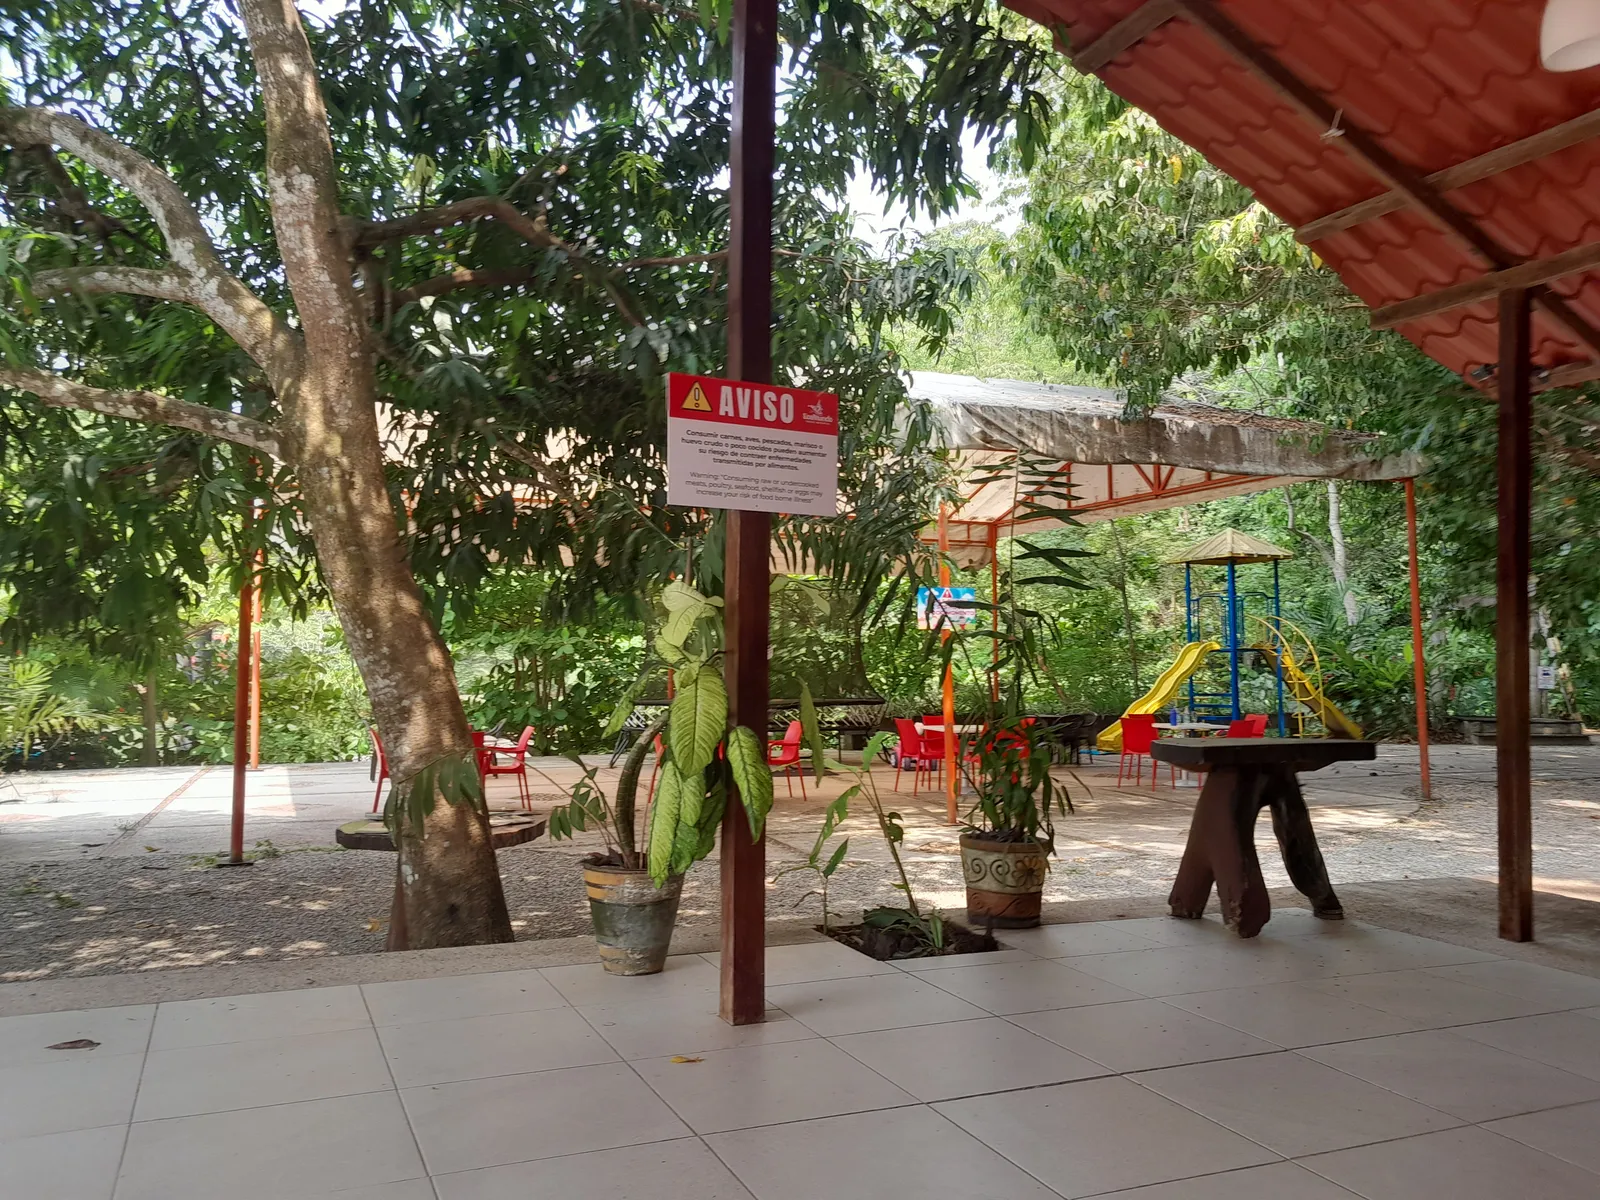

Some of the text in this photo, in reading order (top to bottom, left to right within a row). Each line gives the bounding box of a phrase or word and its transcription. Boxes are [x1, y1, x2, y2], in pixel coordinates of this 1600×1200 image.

[719, 385, 794, 424] AVISO
[686, 430, 718, 438] Consumir
[762, 438, 792, 446] pescados,
[708, 448, 728, 456] riesgo
[768, 455, 812, 464] enfermedades
[712, 458, 754, 466] transmitidas
[767, 462, 800, 470] alimentos.
[690, 472, 719, 480] Warning:
[696, 488, 722, 496] increase
[708, 482, 734, 490] poultry,
